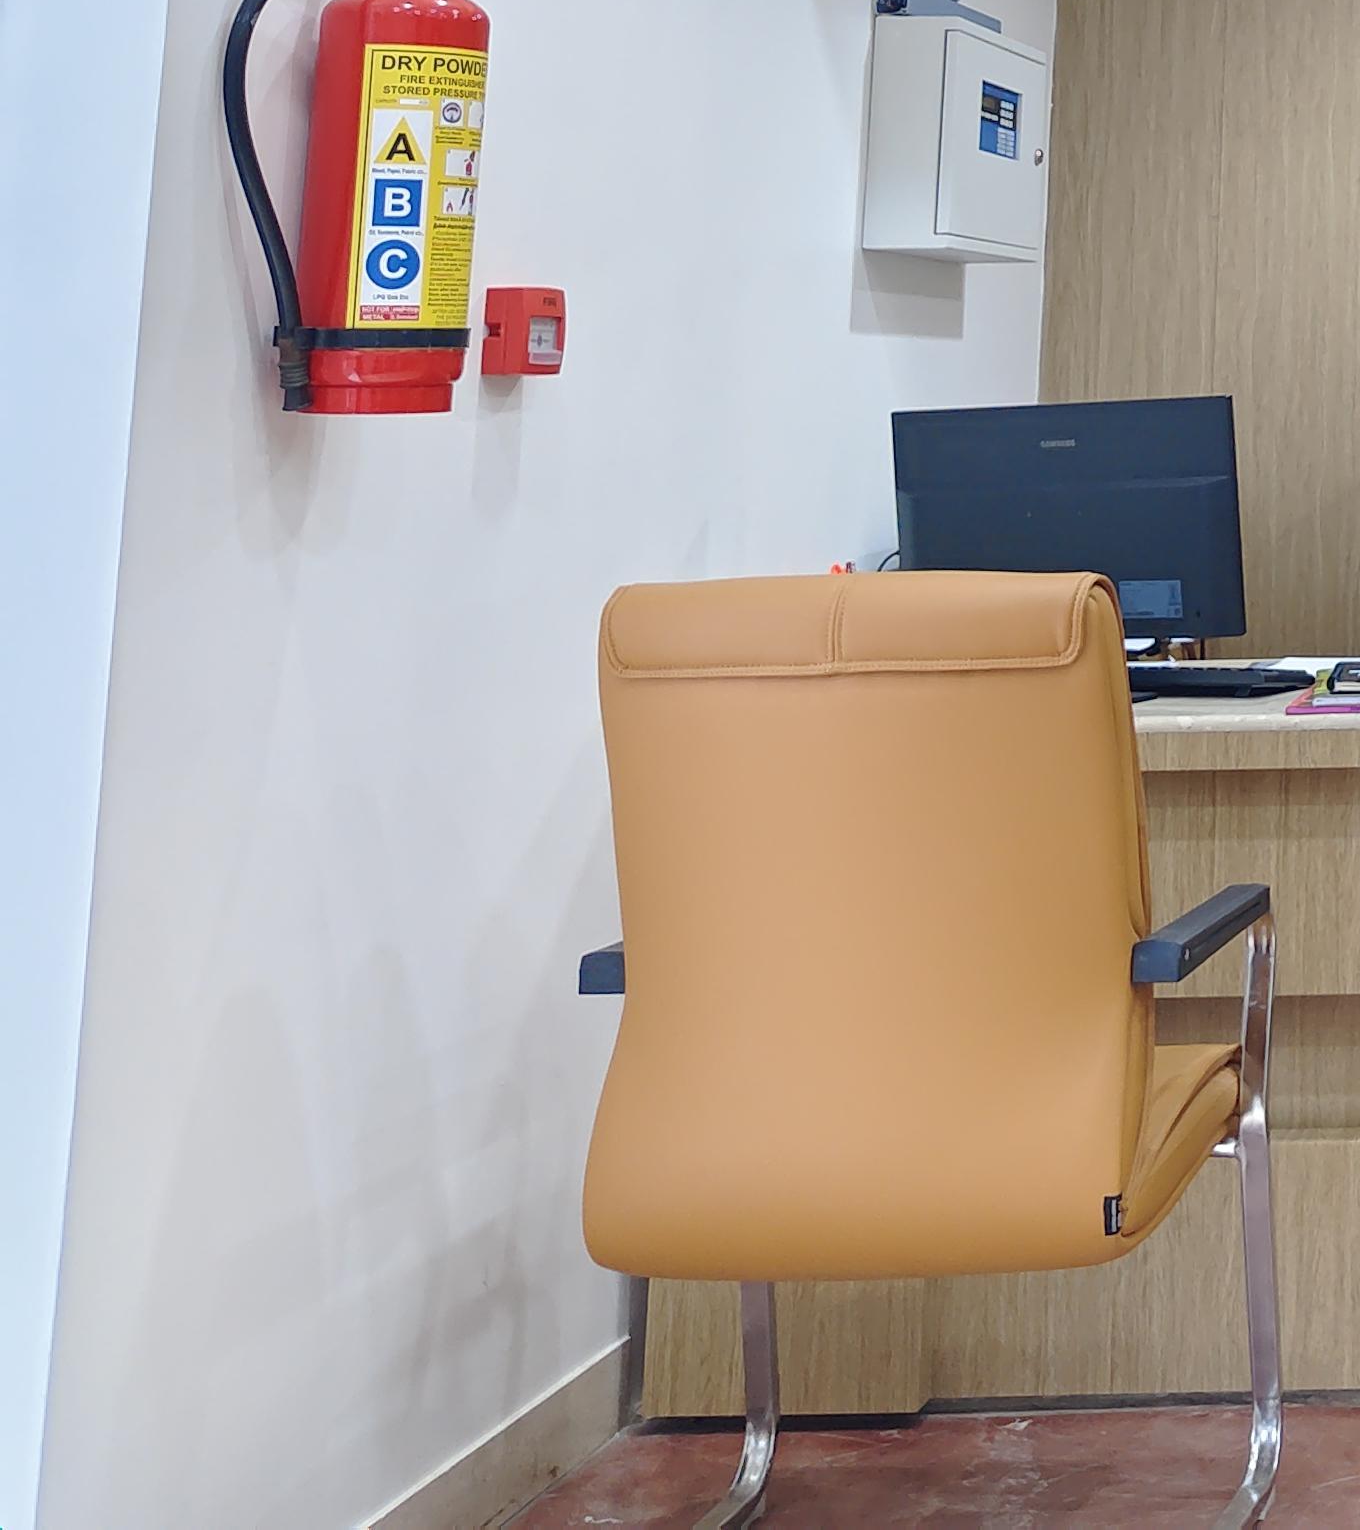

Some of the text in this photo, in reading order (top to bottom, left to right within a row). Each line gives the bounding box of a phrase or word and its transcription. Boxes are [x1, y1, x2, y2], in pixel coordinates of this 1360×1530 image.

[381, 55, 487, 77] DRY POWDE
[383, 85, 430, 96] STORED
[400, 74, 425, 84] FIRE
[385, 132, 415, 161] A
[383, 186, 412, 218] B
[379, 248, 408, 280] C
